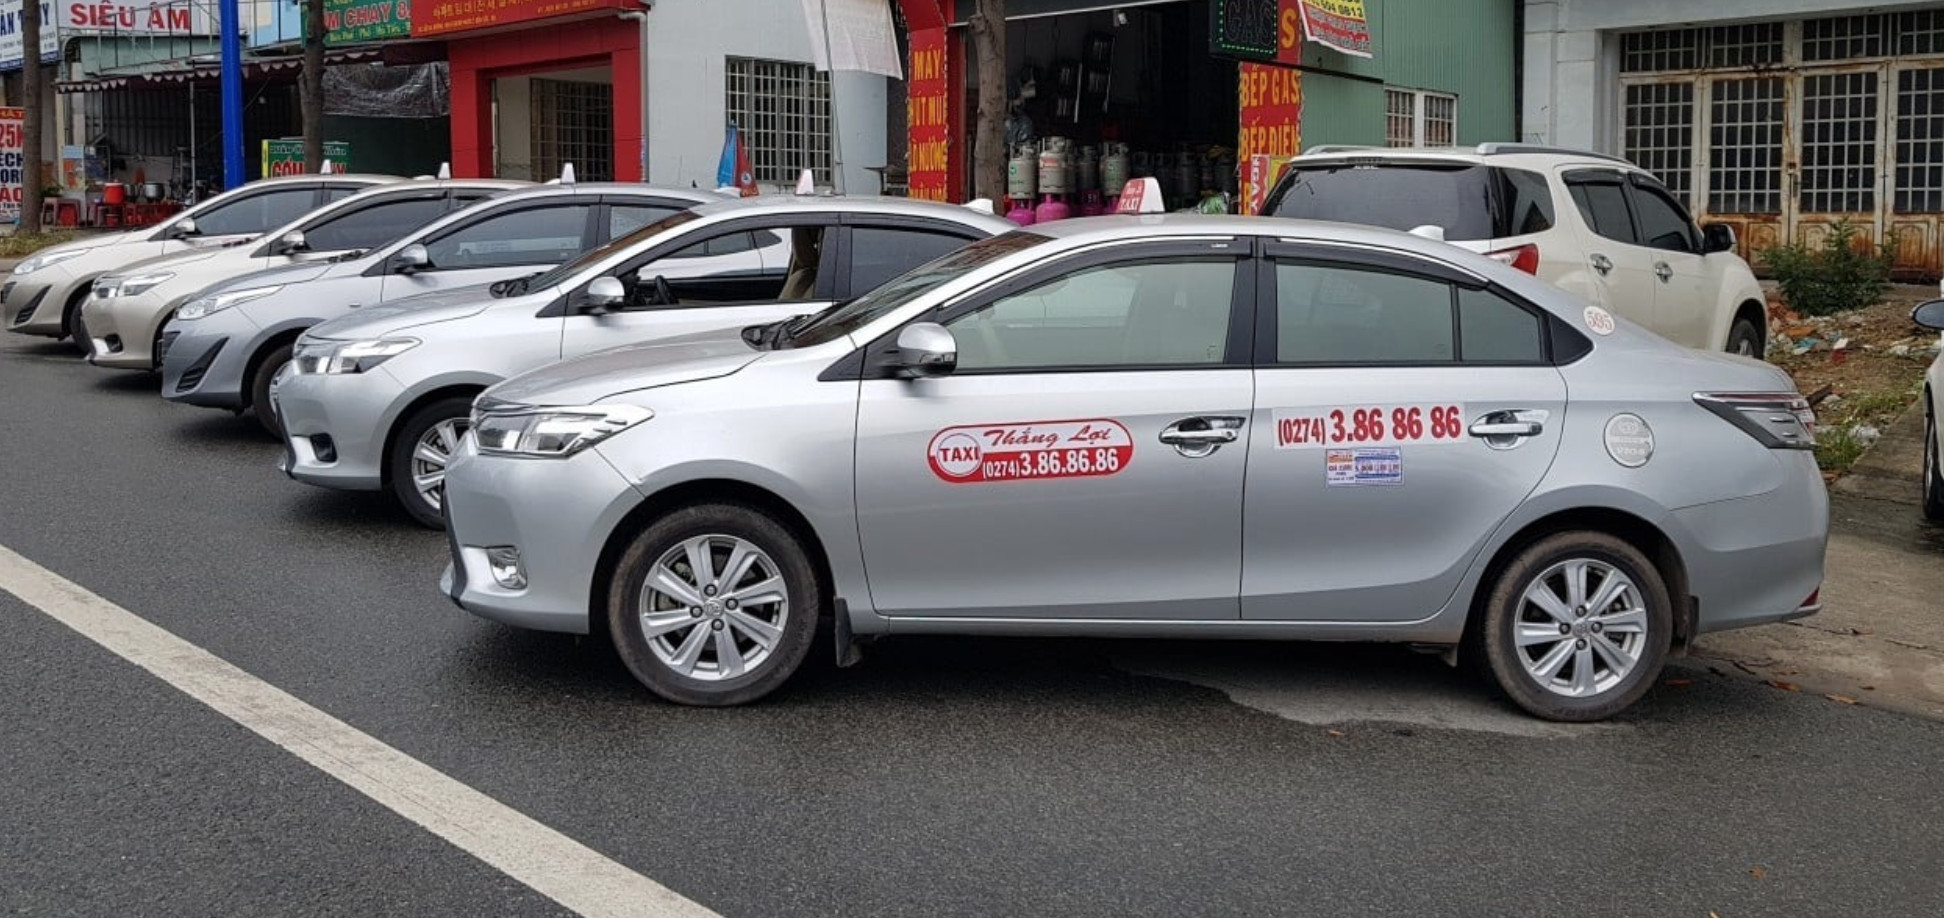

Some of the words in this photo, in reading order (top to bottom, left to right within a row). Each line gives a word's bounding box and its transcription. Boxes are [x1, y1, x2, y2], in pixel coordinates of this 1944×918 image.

[70, 0, 135, 27] SIÊU
[344, 3, 391, 28] CHAY
[914, 44, 941, 81] MÁY
[1241, 65, 1267, 107] BẾP
[1272, 68, 1300, 106] GAS
[1241, 116, 1266, 163] BẾP
[983, 426, 1060, 447] Thắng
[1067, 424, 1112, 445] Lợi
[1278, 417, 1326, 446] (0274)
[1330, 408, 1384, 442] 3.86
[1392, 407, 1423, 440] 86
[1430, 405, 1461, 439] 86
[938, 446, 980, 462] TAXI
